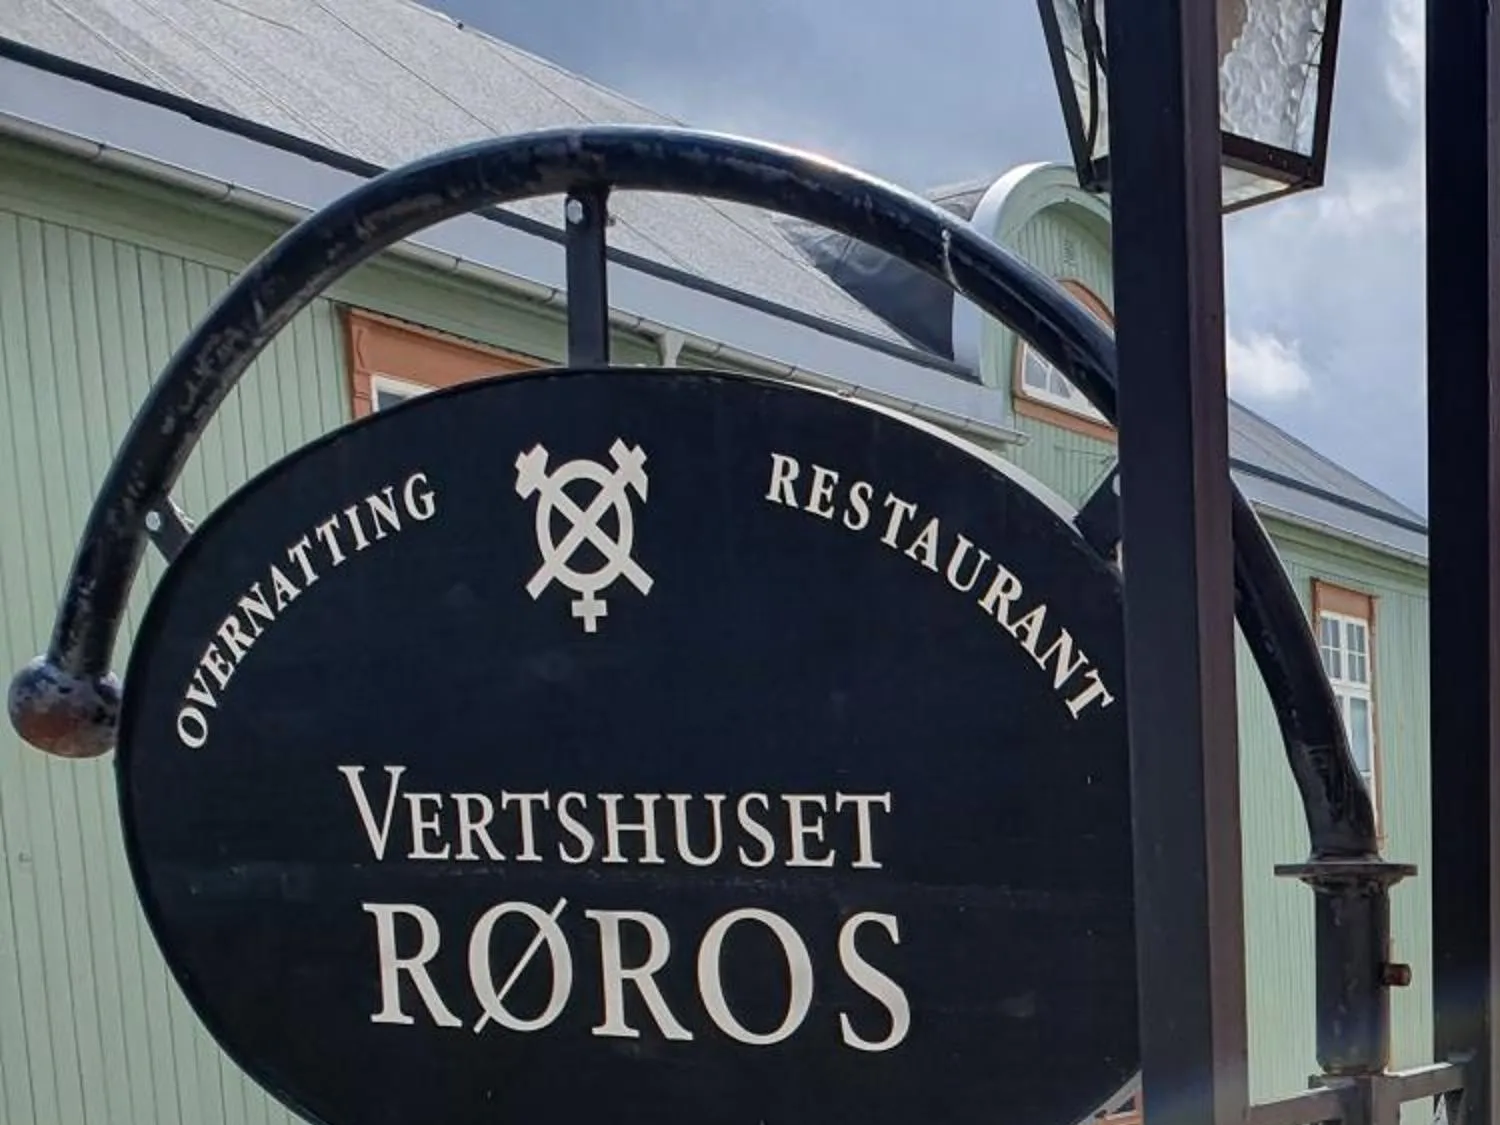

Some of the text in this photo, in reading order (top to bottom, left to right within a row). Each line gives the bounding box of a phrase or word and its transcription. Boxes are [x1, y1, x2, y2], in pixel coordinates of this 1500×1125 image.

[177, 472, 436, 749] OVERNATTING
[765, 452, 1115, 720] RESTAURANT
[337, 765, 891, 869] VERTSHUSET
[362, 897, 911, 1052] RØROS
